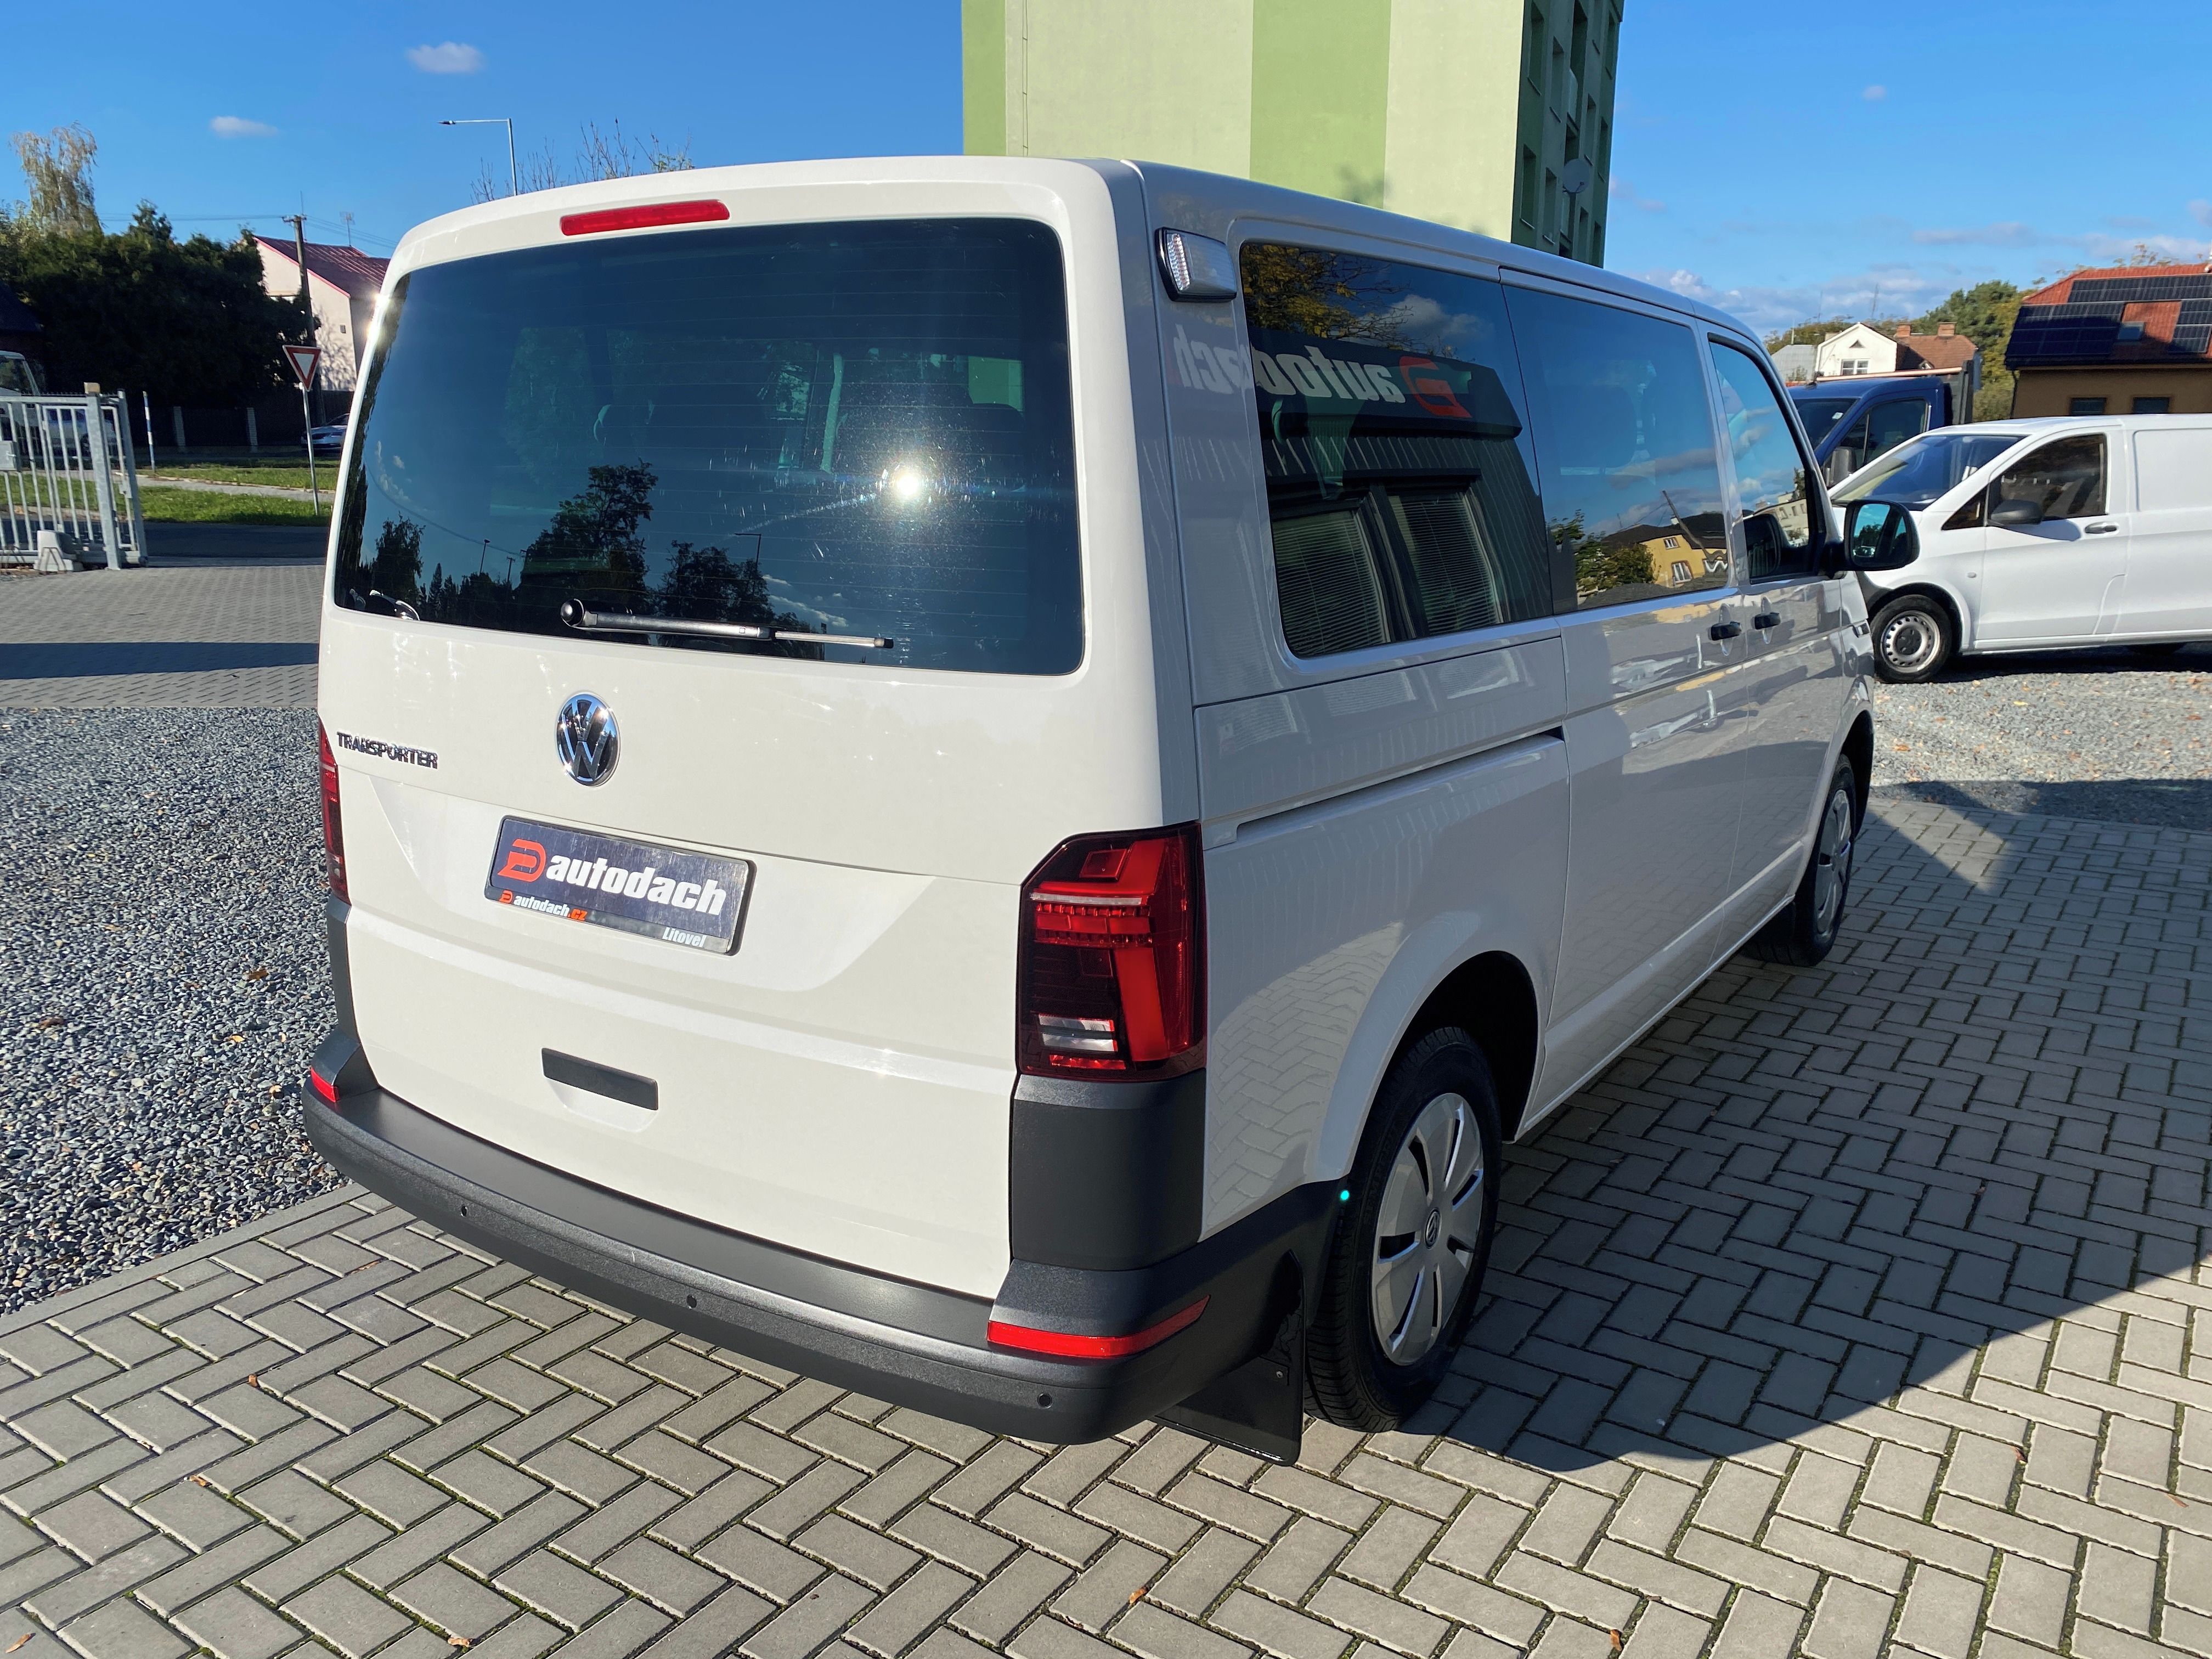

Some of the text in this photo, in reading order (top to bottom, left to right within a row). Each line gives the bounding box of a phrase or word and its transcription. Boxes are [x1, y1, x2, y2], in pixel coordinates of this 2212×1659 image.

[336, 731, 438, 769] TRANSPORTER
[546, 855, 727, 916] autodach
[513, 895, 589, 921] autodach.cz
[662, 927, 707, 947] Litovel
